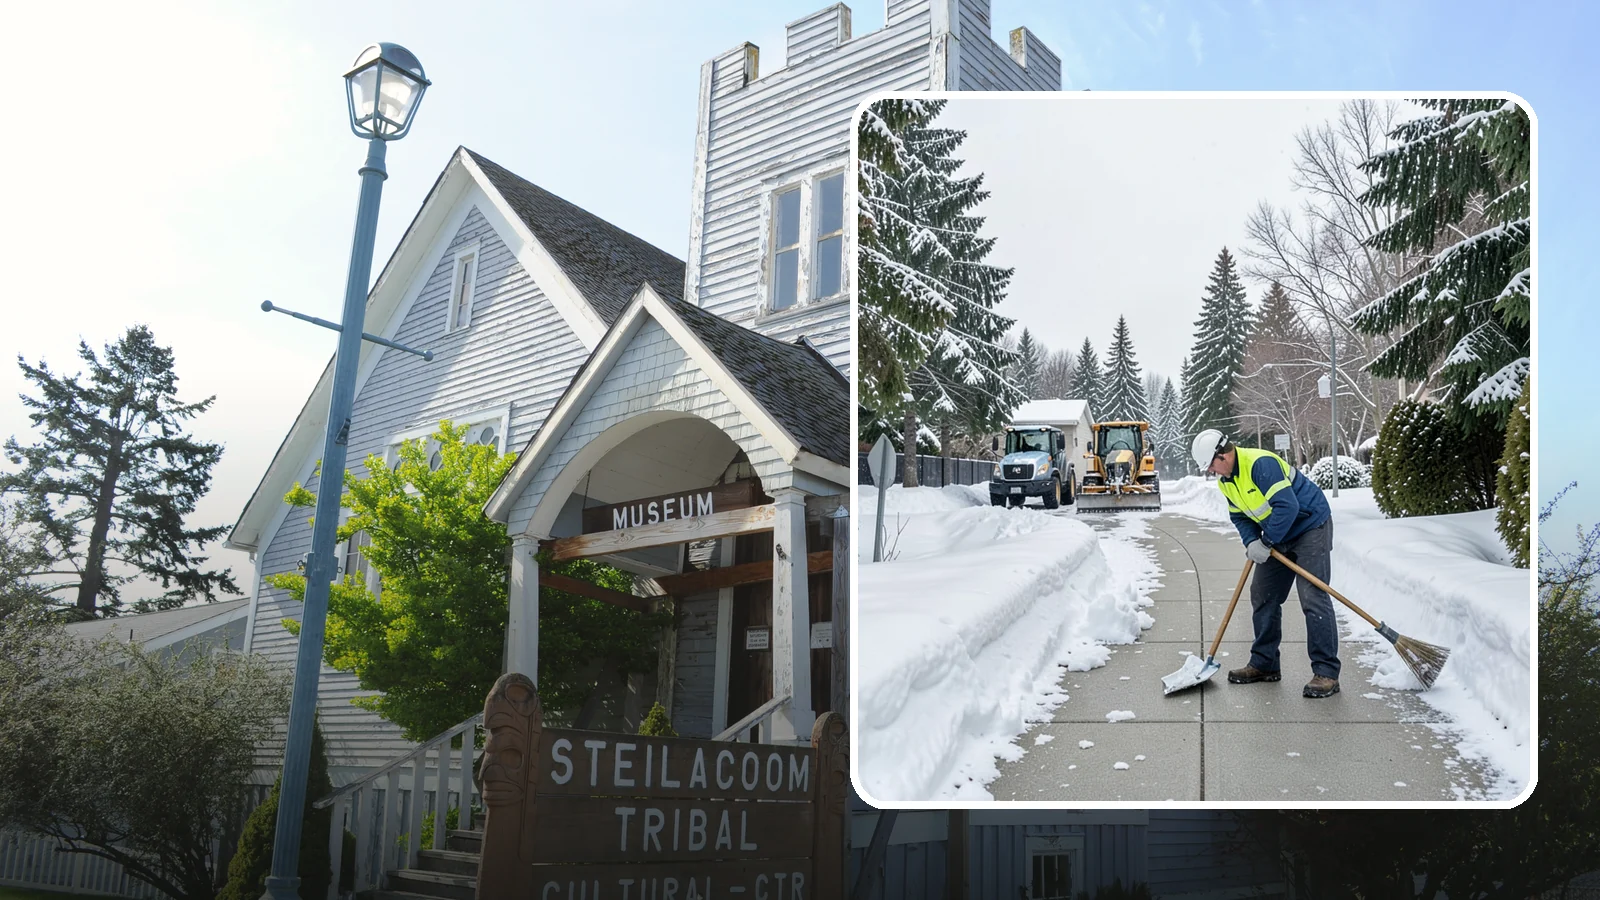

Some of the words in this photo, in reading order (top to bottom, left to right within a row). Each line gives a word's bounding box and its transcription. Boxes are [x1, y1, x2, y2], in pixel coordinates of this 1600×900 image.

[613, 491, 713, 531] MUSEUM
[551, 738, 810, 792] STEILACOOM
[615, 806, 758, 853] TRIBAL
